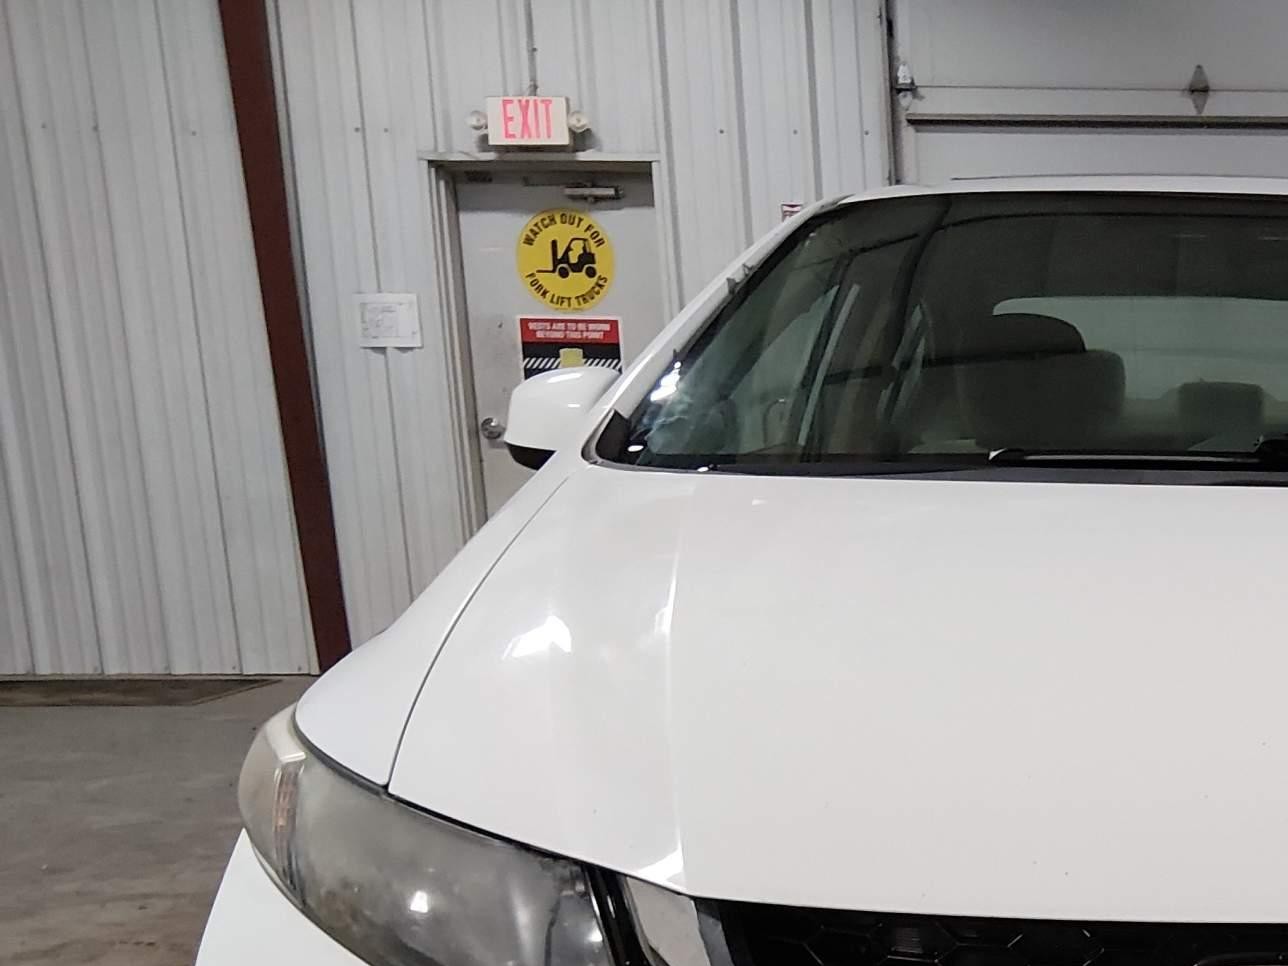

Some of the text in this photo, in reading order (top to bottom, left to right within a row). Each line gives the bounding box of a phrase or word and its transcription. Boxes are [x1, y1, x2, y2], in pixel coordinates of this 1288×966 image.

[502, 99, 552, 139] EXIT
[523, 213, 606, 248] WATCH OUT FOR
[525, 272, 608, 307] FORK LIFT TRUCKS
